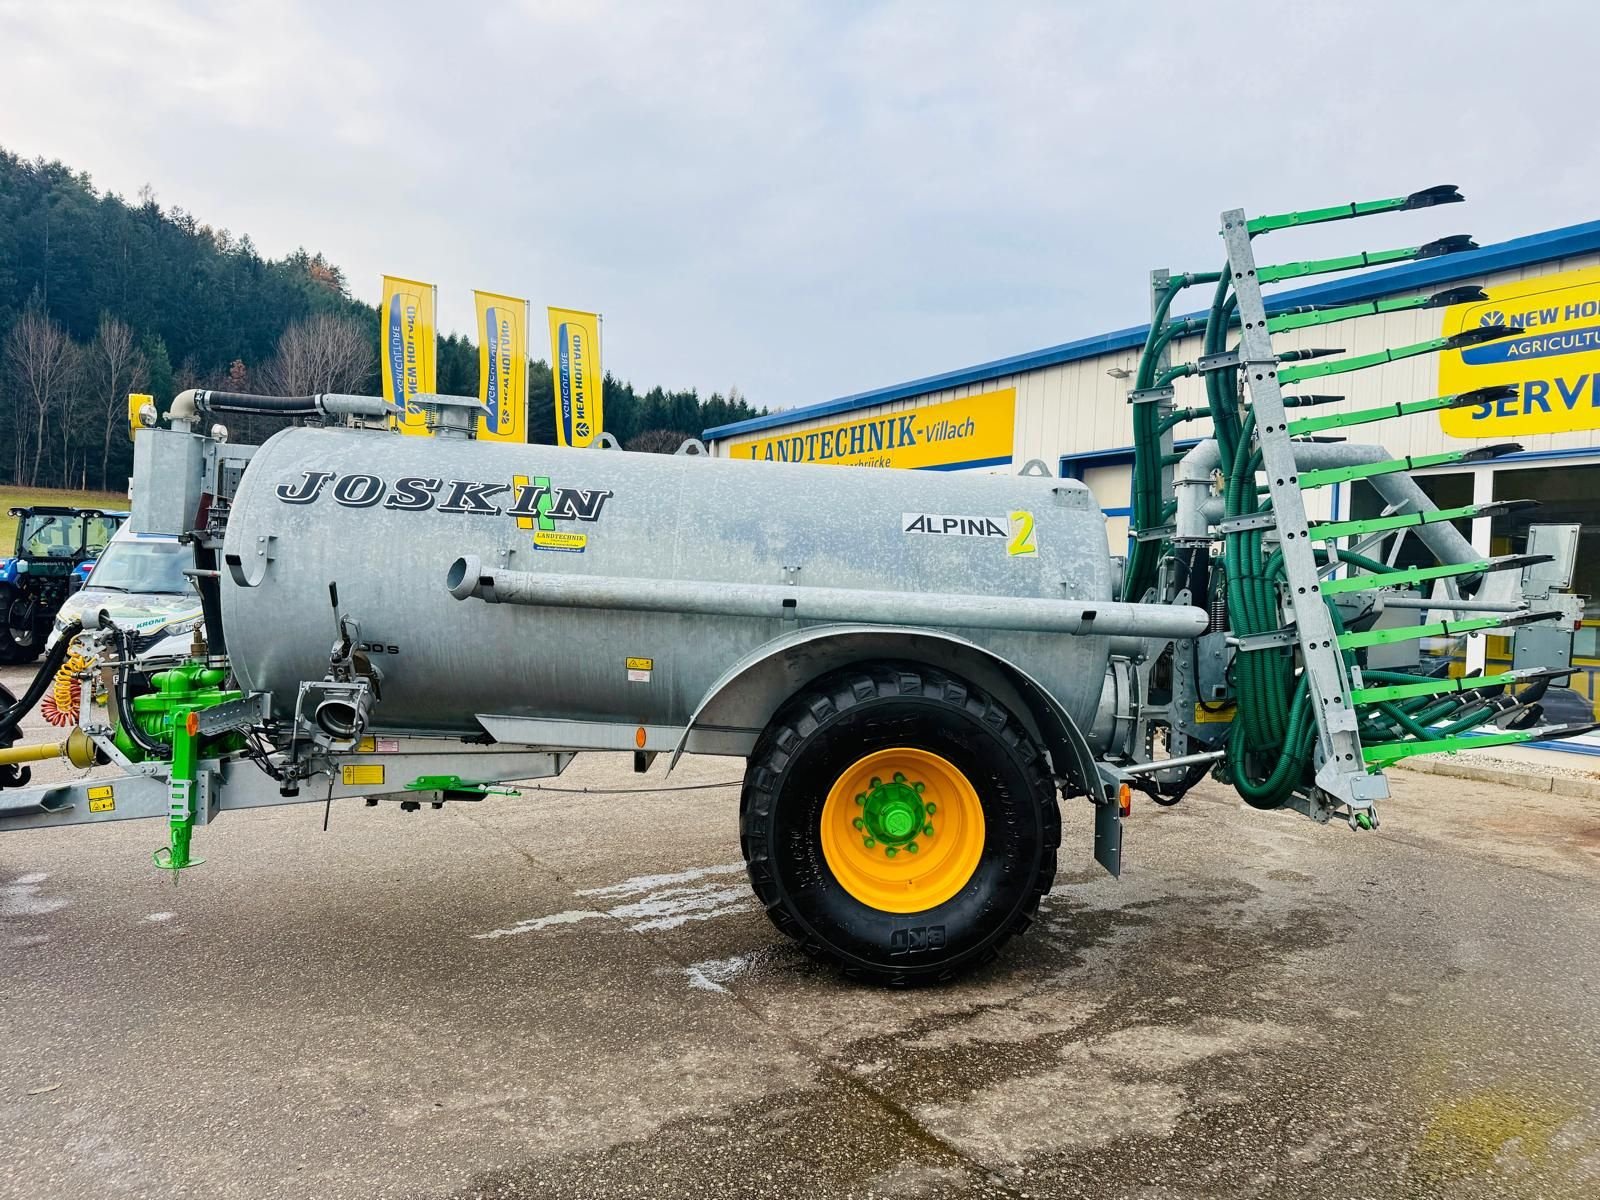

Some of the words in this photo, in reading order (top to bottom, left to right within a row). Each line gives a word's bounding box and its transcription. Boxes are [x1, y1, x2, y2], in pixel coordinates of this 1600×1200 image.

[1509, 307, 1559, 328] NEW
[1564, 300, 1600, 321] HO
[751, 414, 975, 463] LANDTECHNIK-Villach
[275, 471, 614, 522] JOSKIN
[536, 532, 584, 541] LANDTECHNIK
[904, 514, 1008, 537] ALPINA
[1008, 511, 1036, 556] 2
[136, 617, 167, 628] KRONE
[387, 645, 400, 655] S
